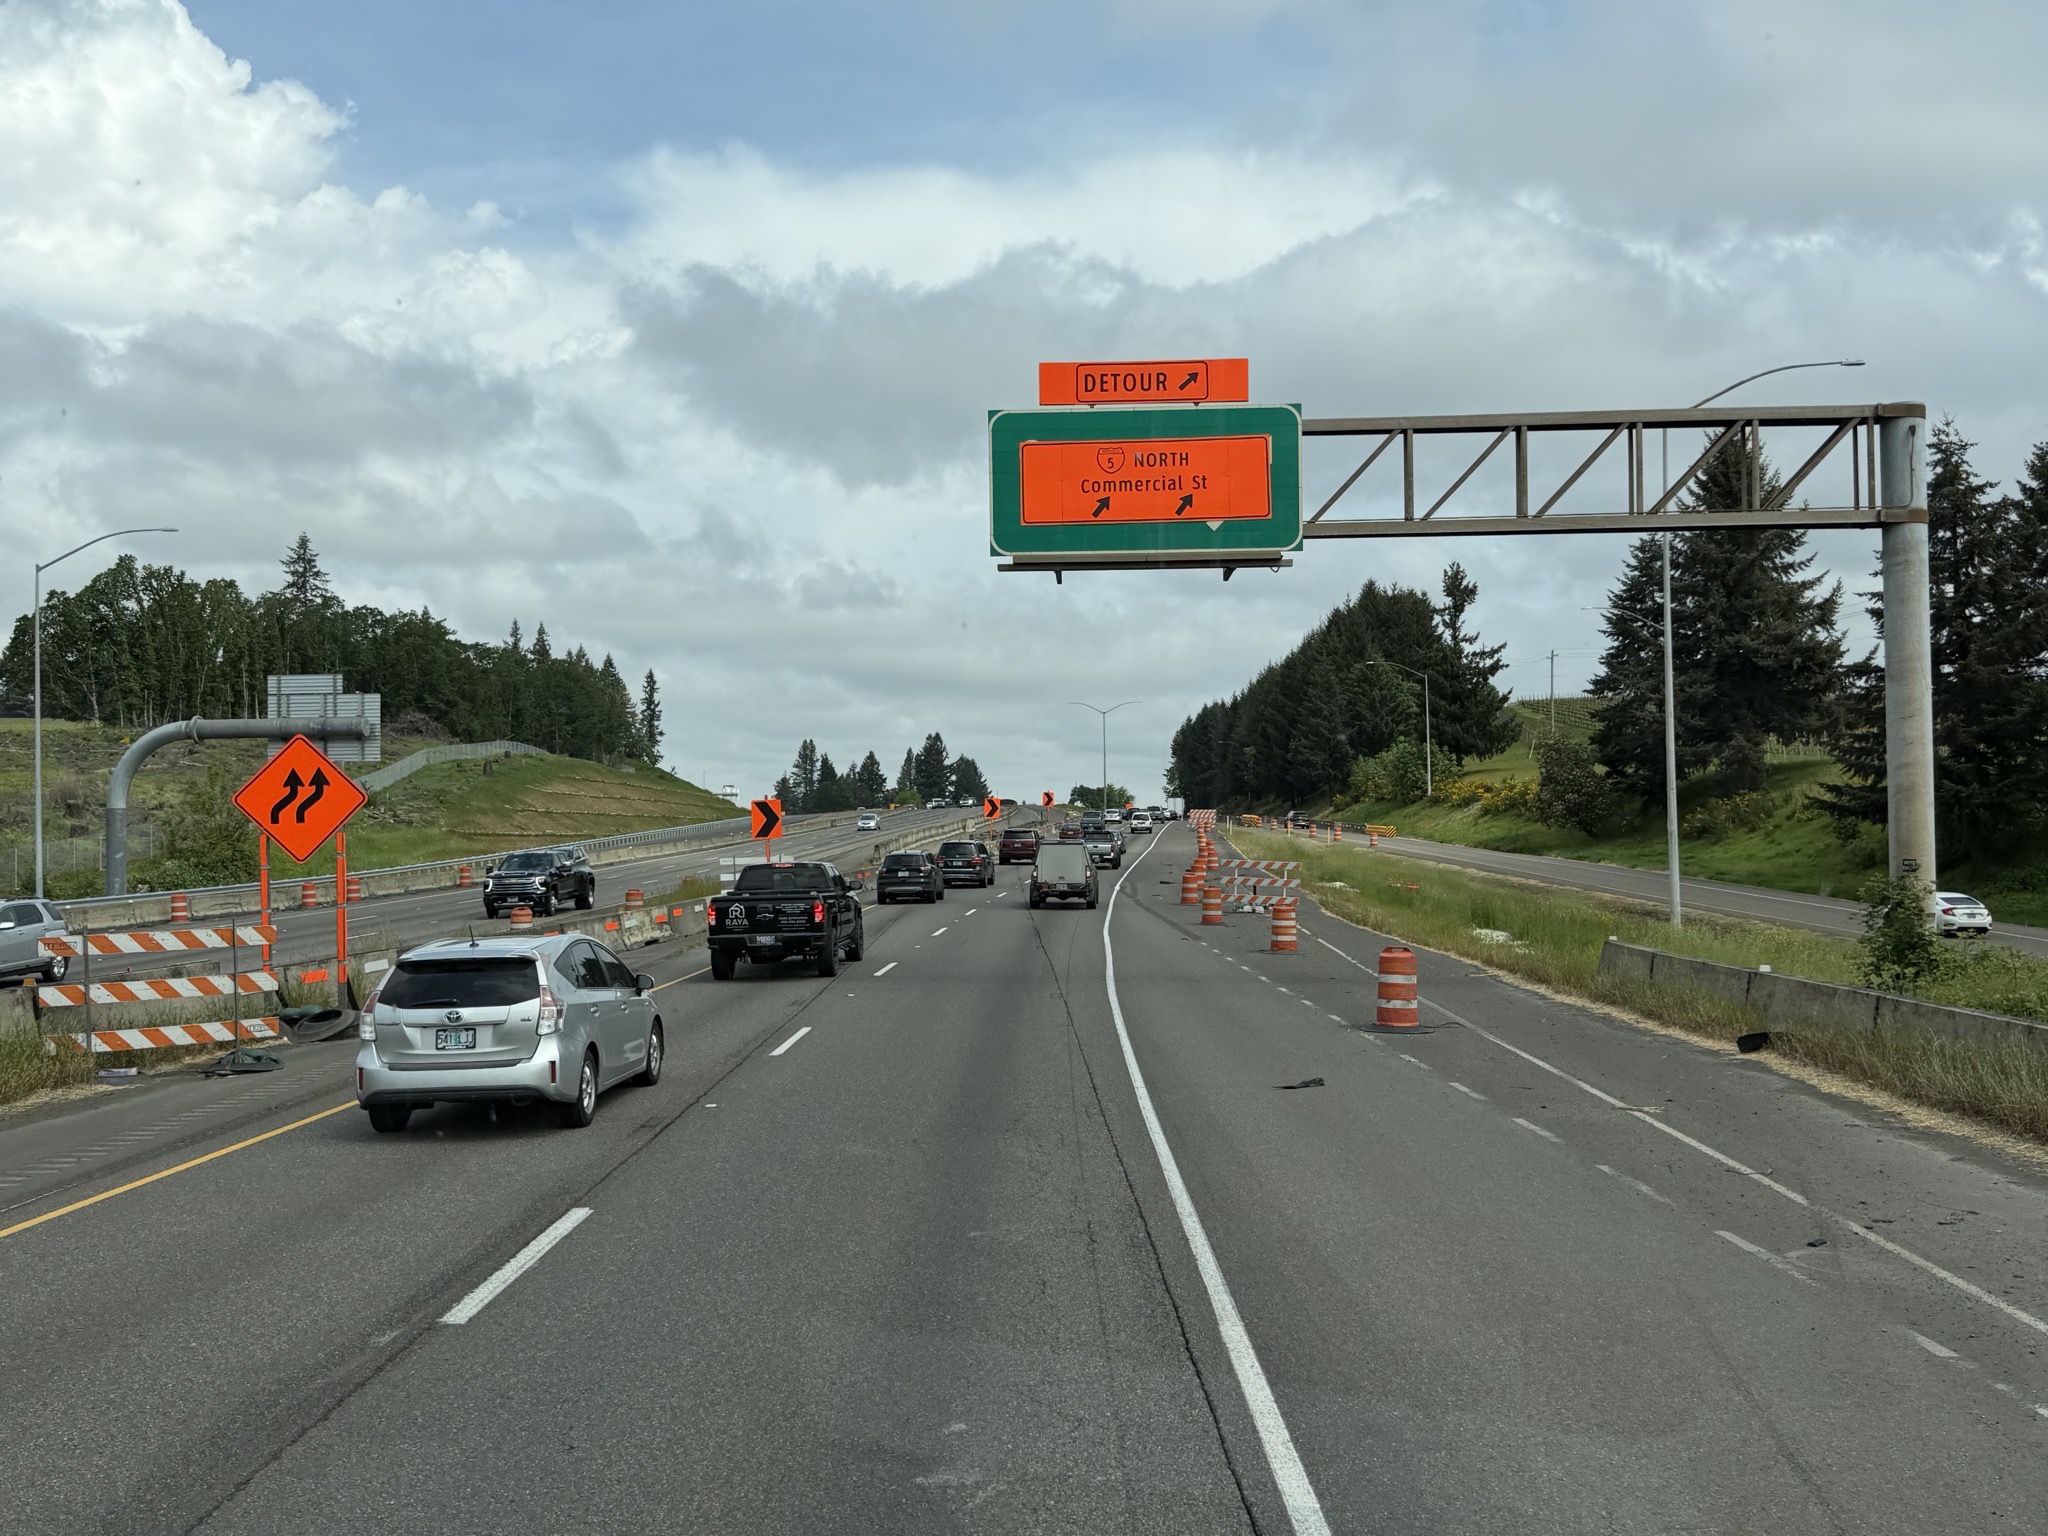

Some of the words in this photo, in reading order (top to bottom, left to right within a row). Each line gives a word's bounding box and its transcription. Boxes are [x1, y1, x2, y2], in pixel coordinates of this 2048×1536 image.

[1084, 372, 1168, 392] DETOUR
[1107, 458, 1114, 469] 5
[1134, 452, 1189, 468] NORTH
[1081, 475, 1183, 494] Commercial
[1192, 474, 1208, 490] St
[725, 918, 749, 926] RAYA
